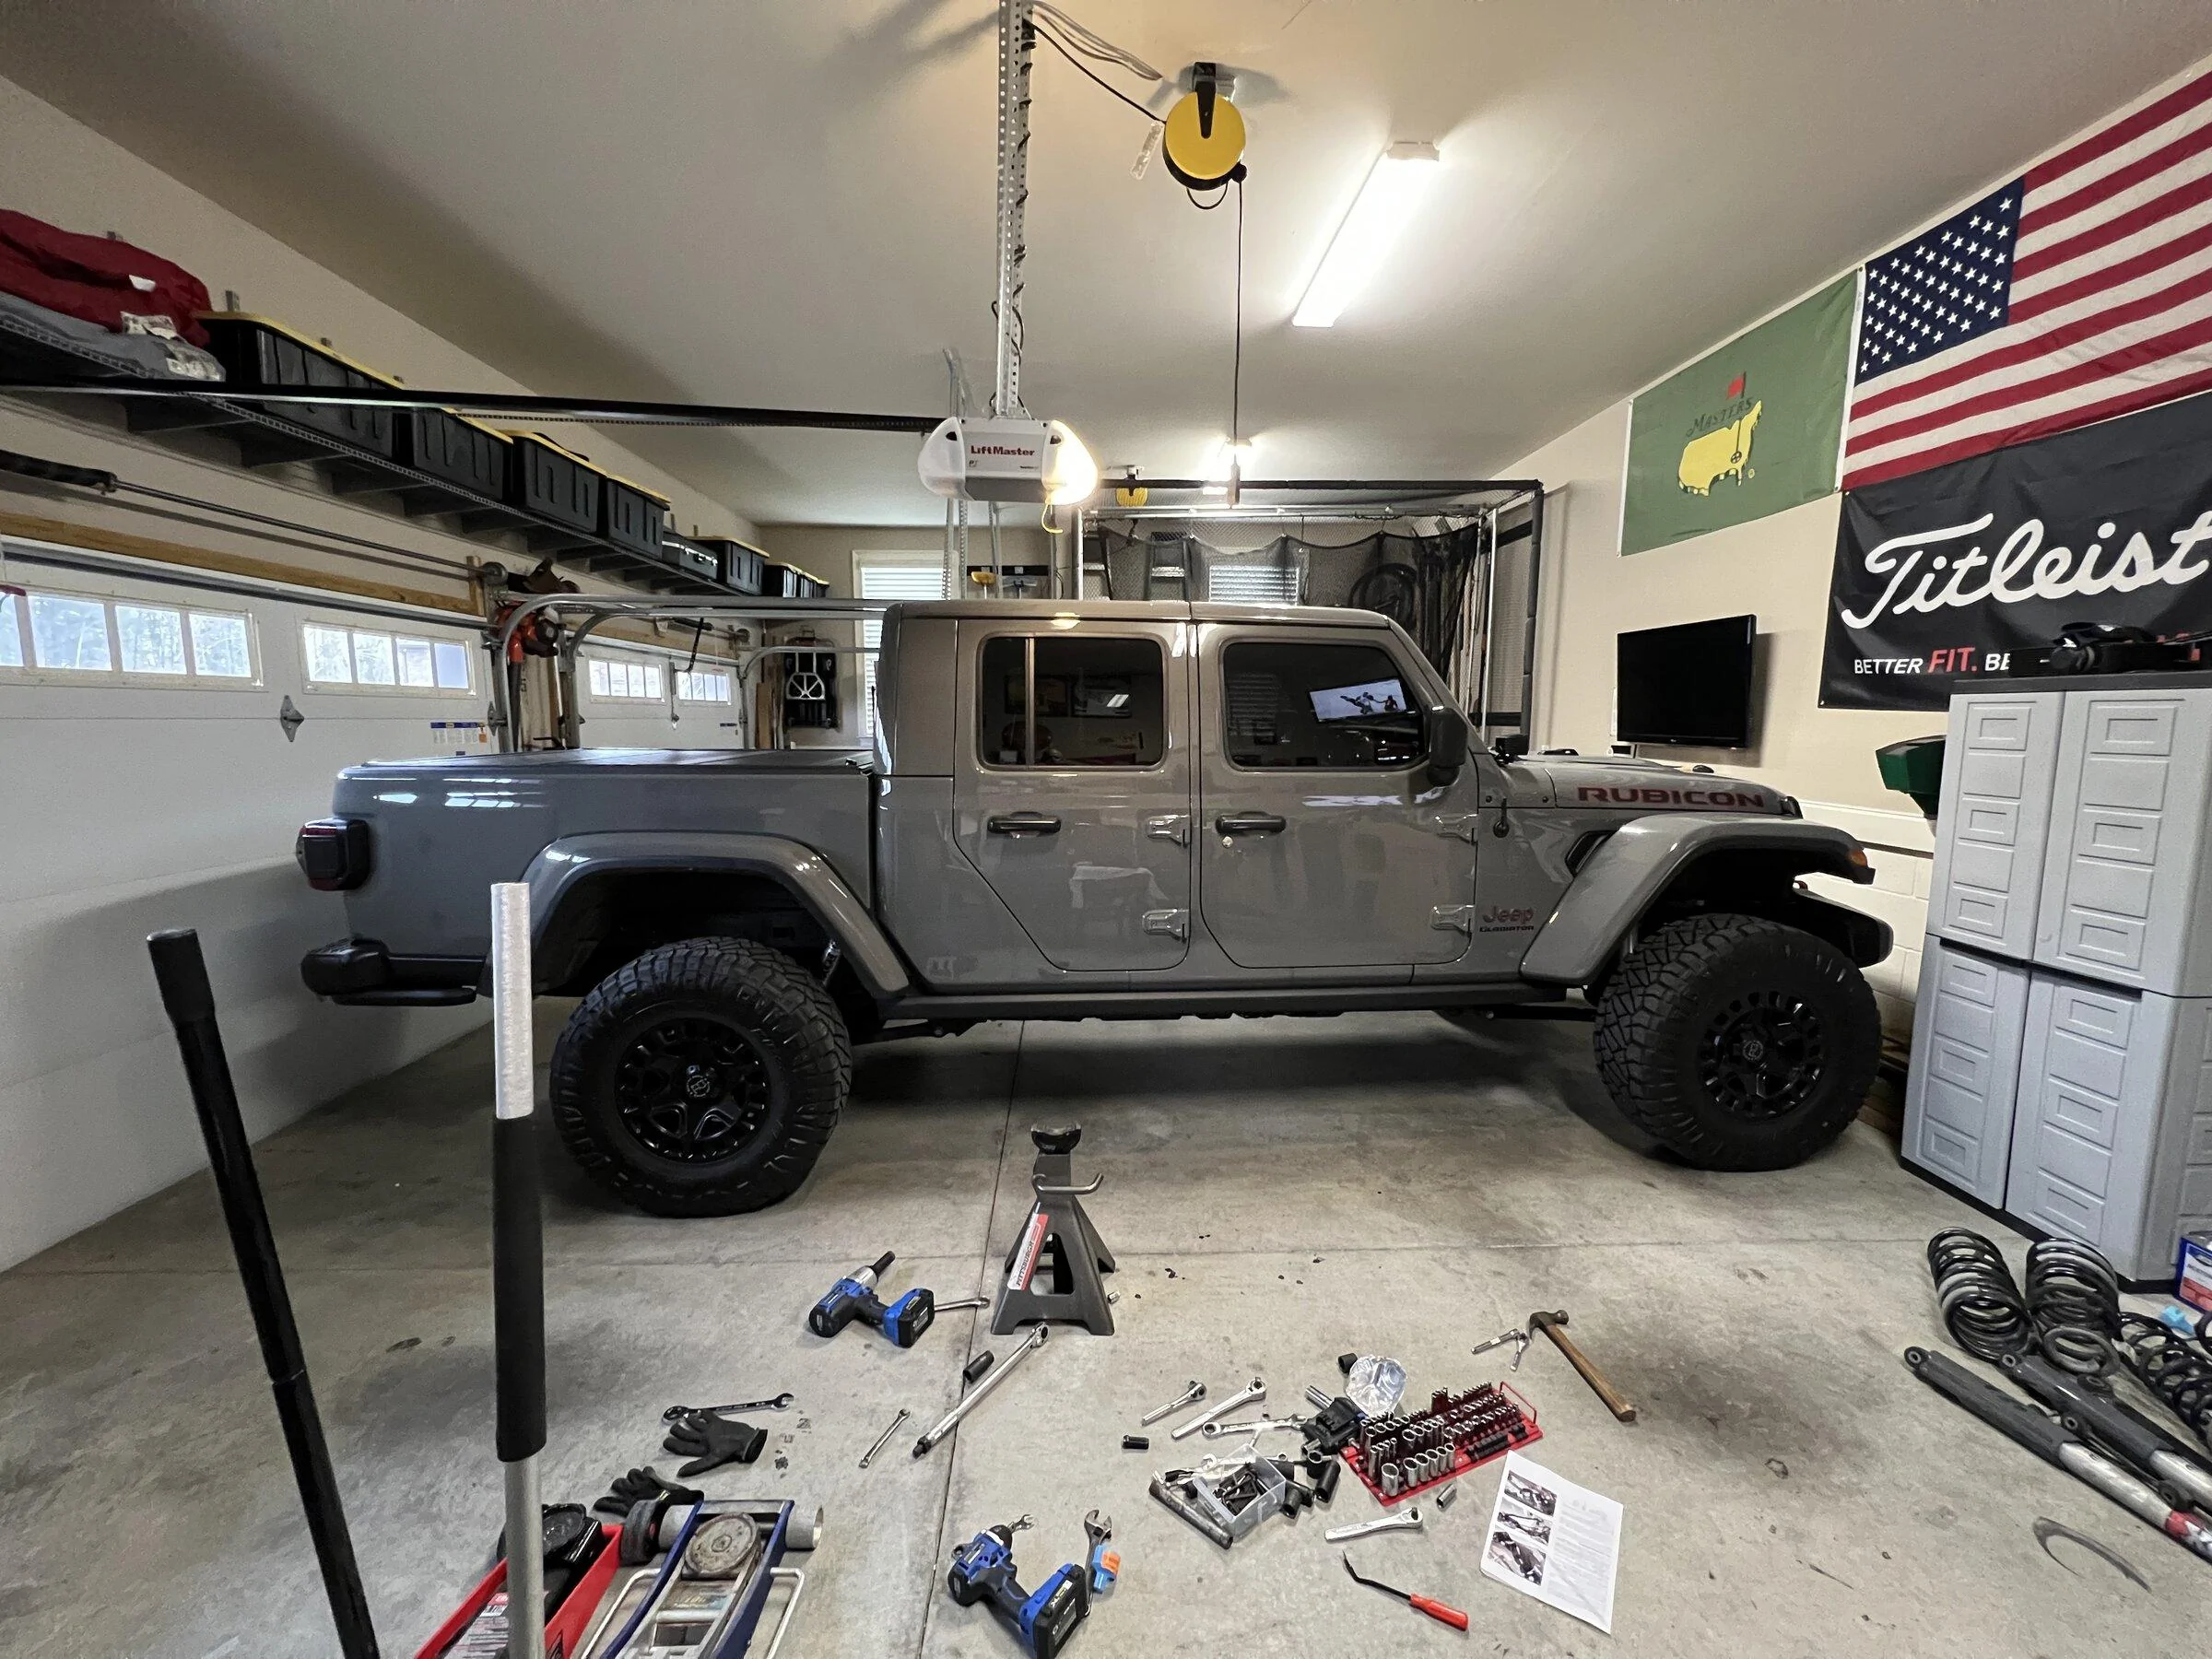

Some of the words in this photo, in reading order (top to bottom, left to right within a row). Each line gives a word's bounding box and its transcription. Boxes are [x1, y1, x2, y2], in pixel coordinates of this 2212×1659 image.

[971, 445, 1035, 456] LiftMaster
[1841, 510, 2212, 629] Titleist
[1853, 658, 1924, 675] BETTER
[1927, 647, 1978, 674] FIT.
[1577, 786, 1764, 808] RUBICON
[1482, 905, 1535, 924] Jeep
